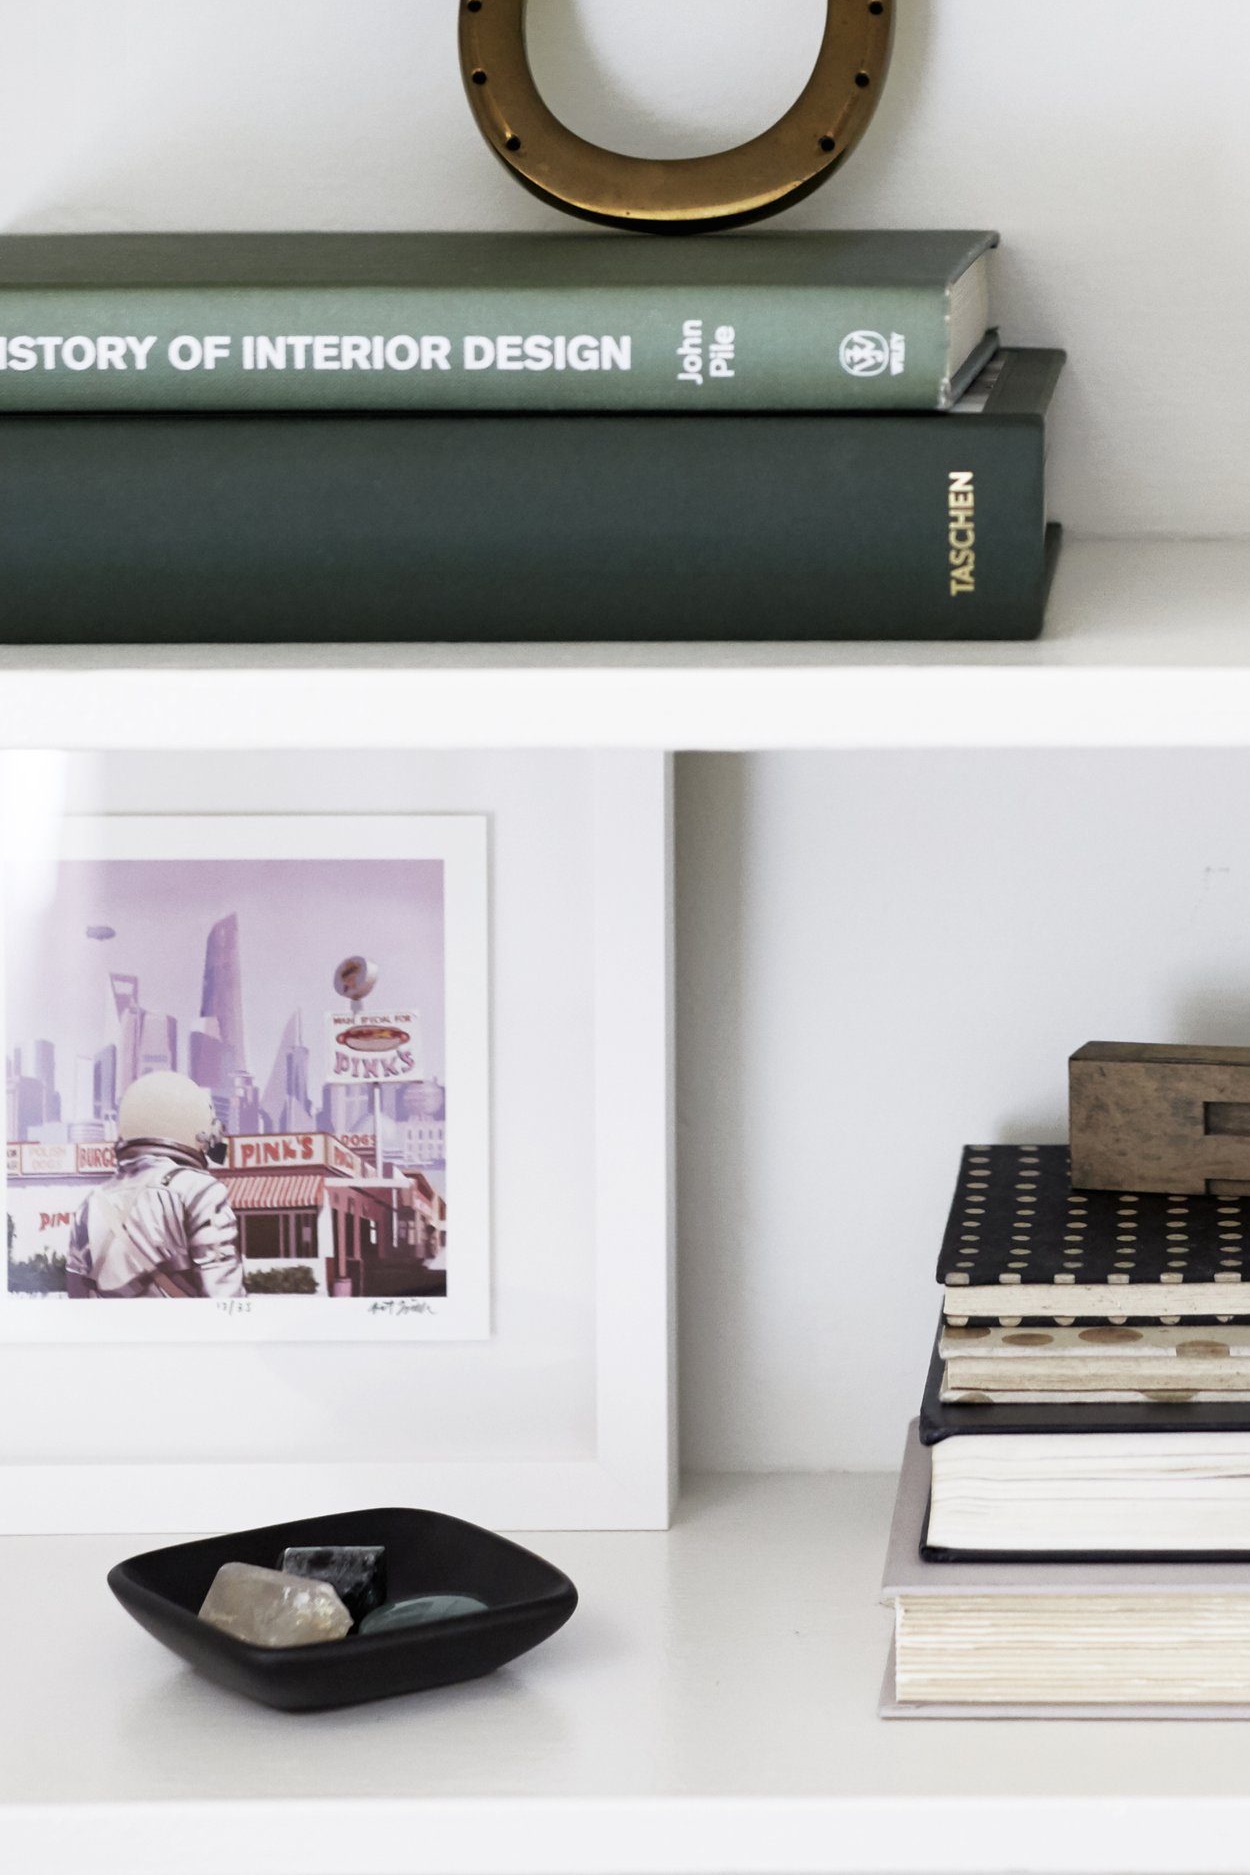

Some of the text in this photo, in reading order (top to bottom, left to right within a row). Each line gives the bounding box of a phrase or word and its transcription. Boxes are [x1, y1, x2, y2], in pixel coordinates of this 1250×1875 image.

[168, 335, 231, 371] OF
[242, 335, 451, 371] INTERIOR
[463, 335, 632, 371] DESIGN
[676, 319, 703, 385] John
[709, 325, 735, 377] Pile
[948, 471, 975, 597] TASCHEN
[333, 1049, 415, 1078] PINK'S
[240, 1136, 314, 1167] PINK'S
